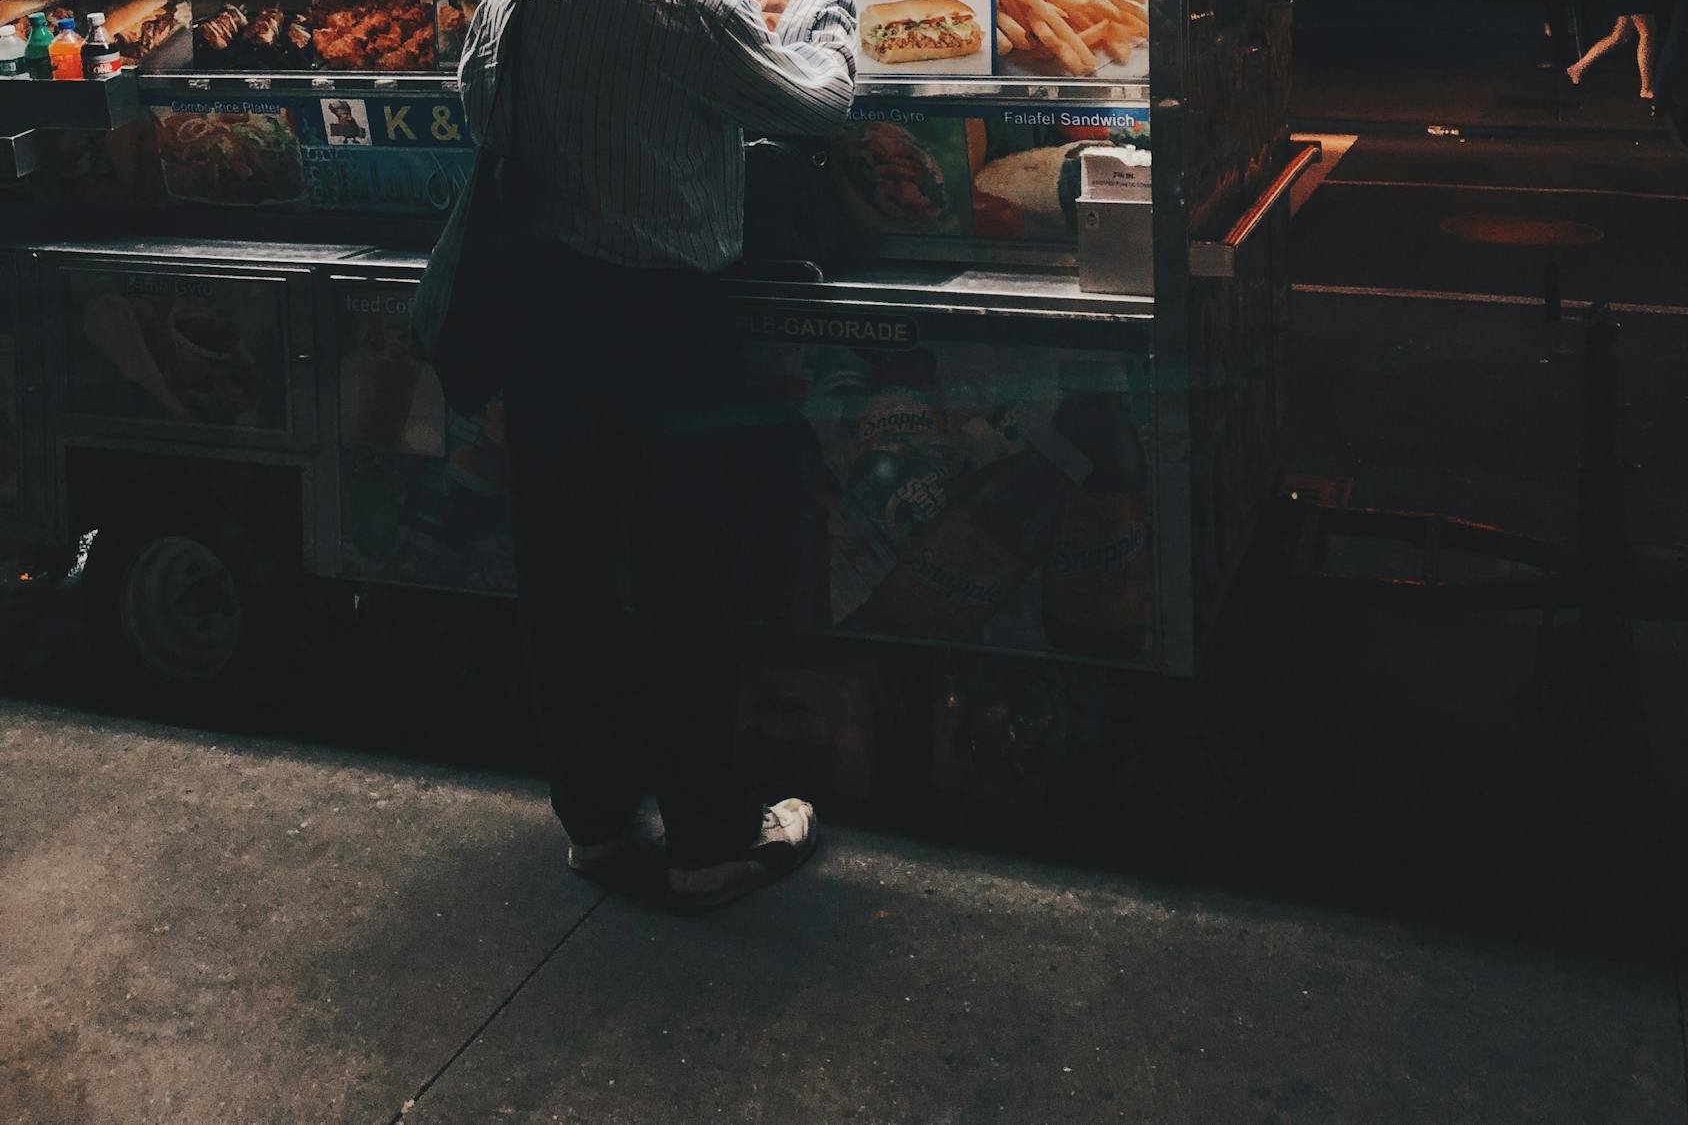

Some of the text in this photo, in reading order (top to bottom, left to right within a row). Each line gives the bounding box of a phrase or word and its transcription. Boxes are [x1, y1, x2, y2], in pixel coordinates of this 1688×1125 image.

[170, 100, 281, 115] Combo Rice Platter
[889, 108, 926, 124] Gyro
[1004, 110, 1135, 128] Falafel Sandwich
[384, 105, 462, 142] K &
[346, 294, 381, 314] Iced
[862, 409, 935, 437] Snapple
[1053, 523, 1145, 574] Snapple
[911, 545, 1001, 604] Snapple
